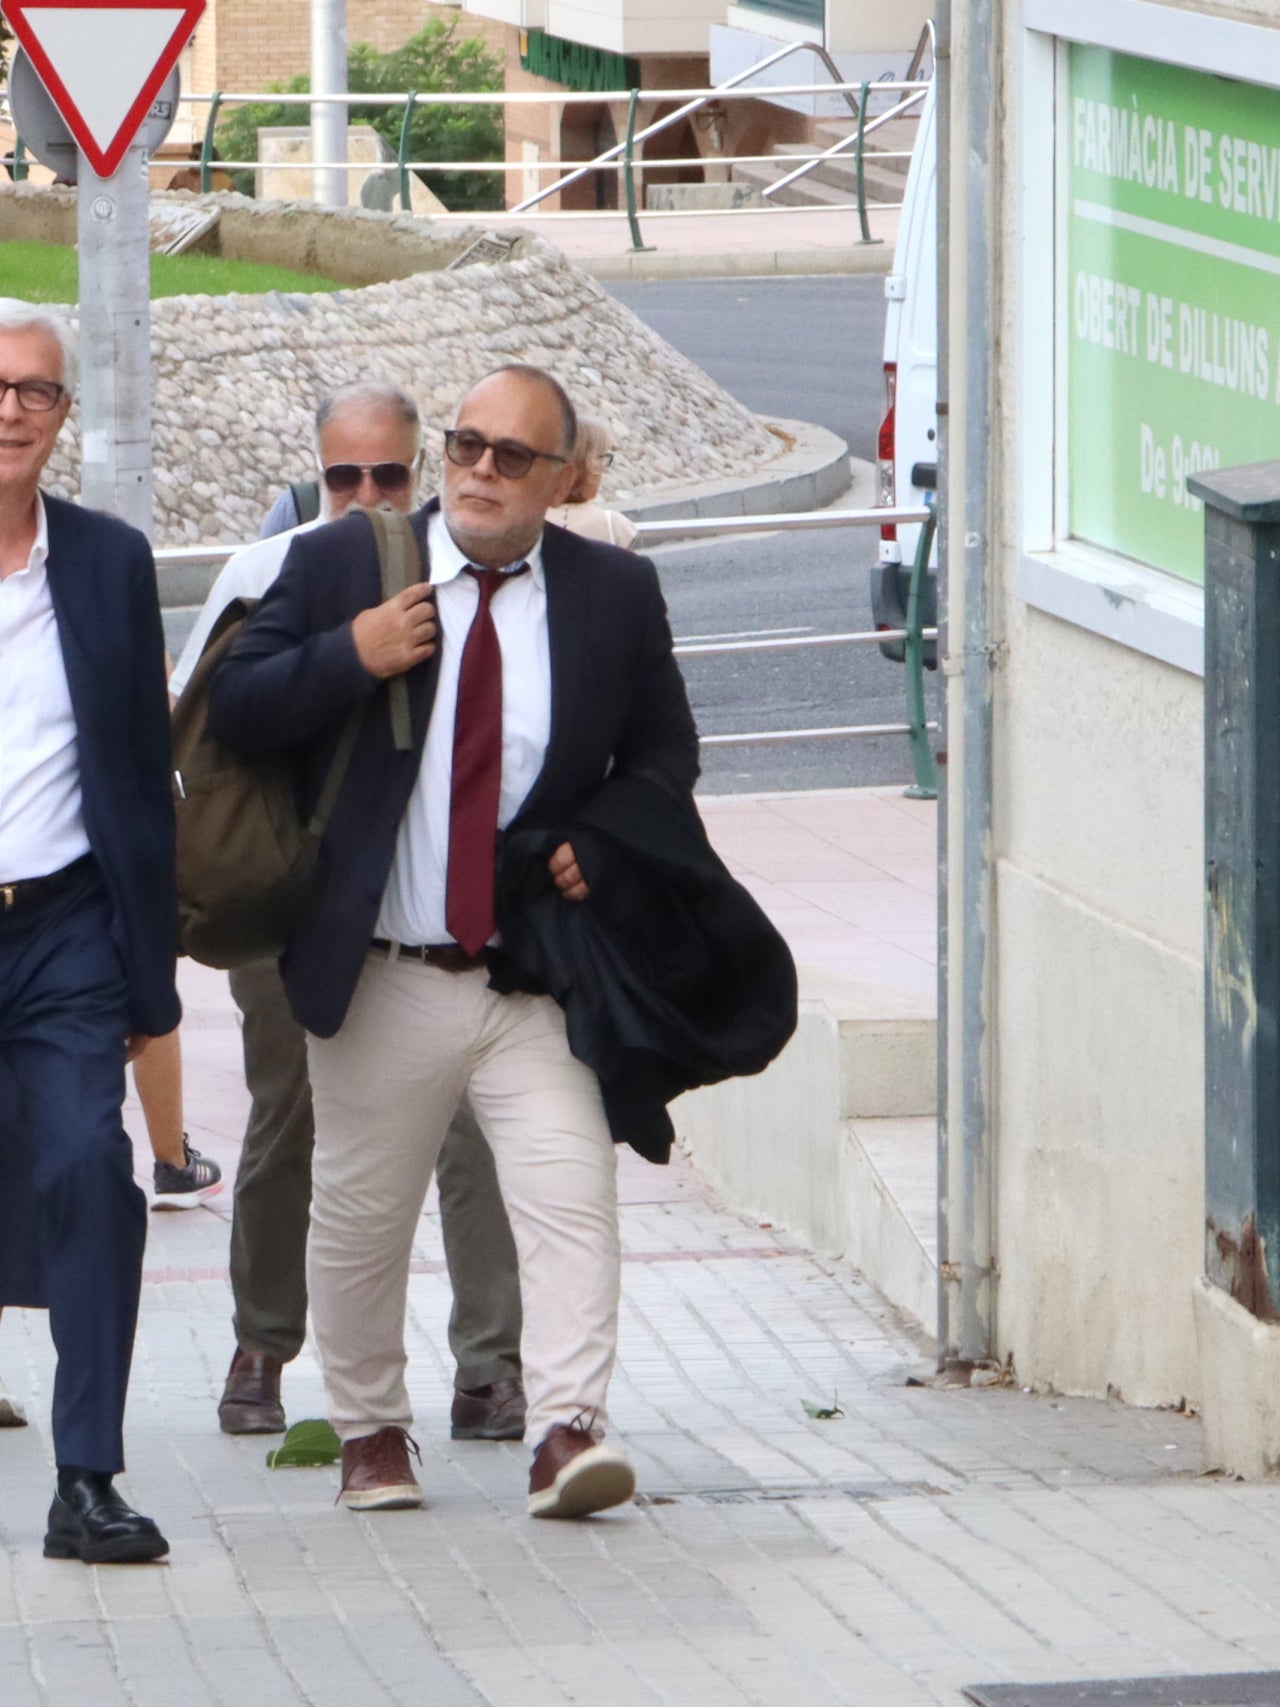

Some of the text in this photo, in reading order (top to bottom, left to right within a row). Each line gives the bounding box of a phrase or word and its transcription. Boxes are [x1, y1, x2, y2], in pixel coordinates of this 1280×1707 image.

[1074, 94, 1280, 223] FARMÀCIA DE SERV
[1075, 271, 1141, 356] OBERT
[1147, 292, 1174, 368] DE
[1179, 302, 1269, 400] DILLUNS
[1141, 422, 1166, 499] De
